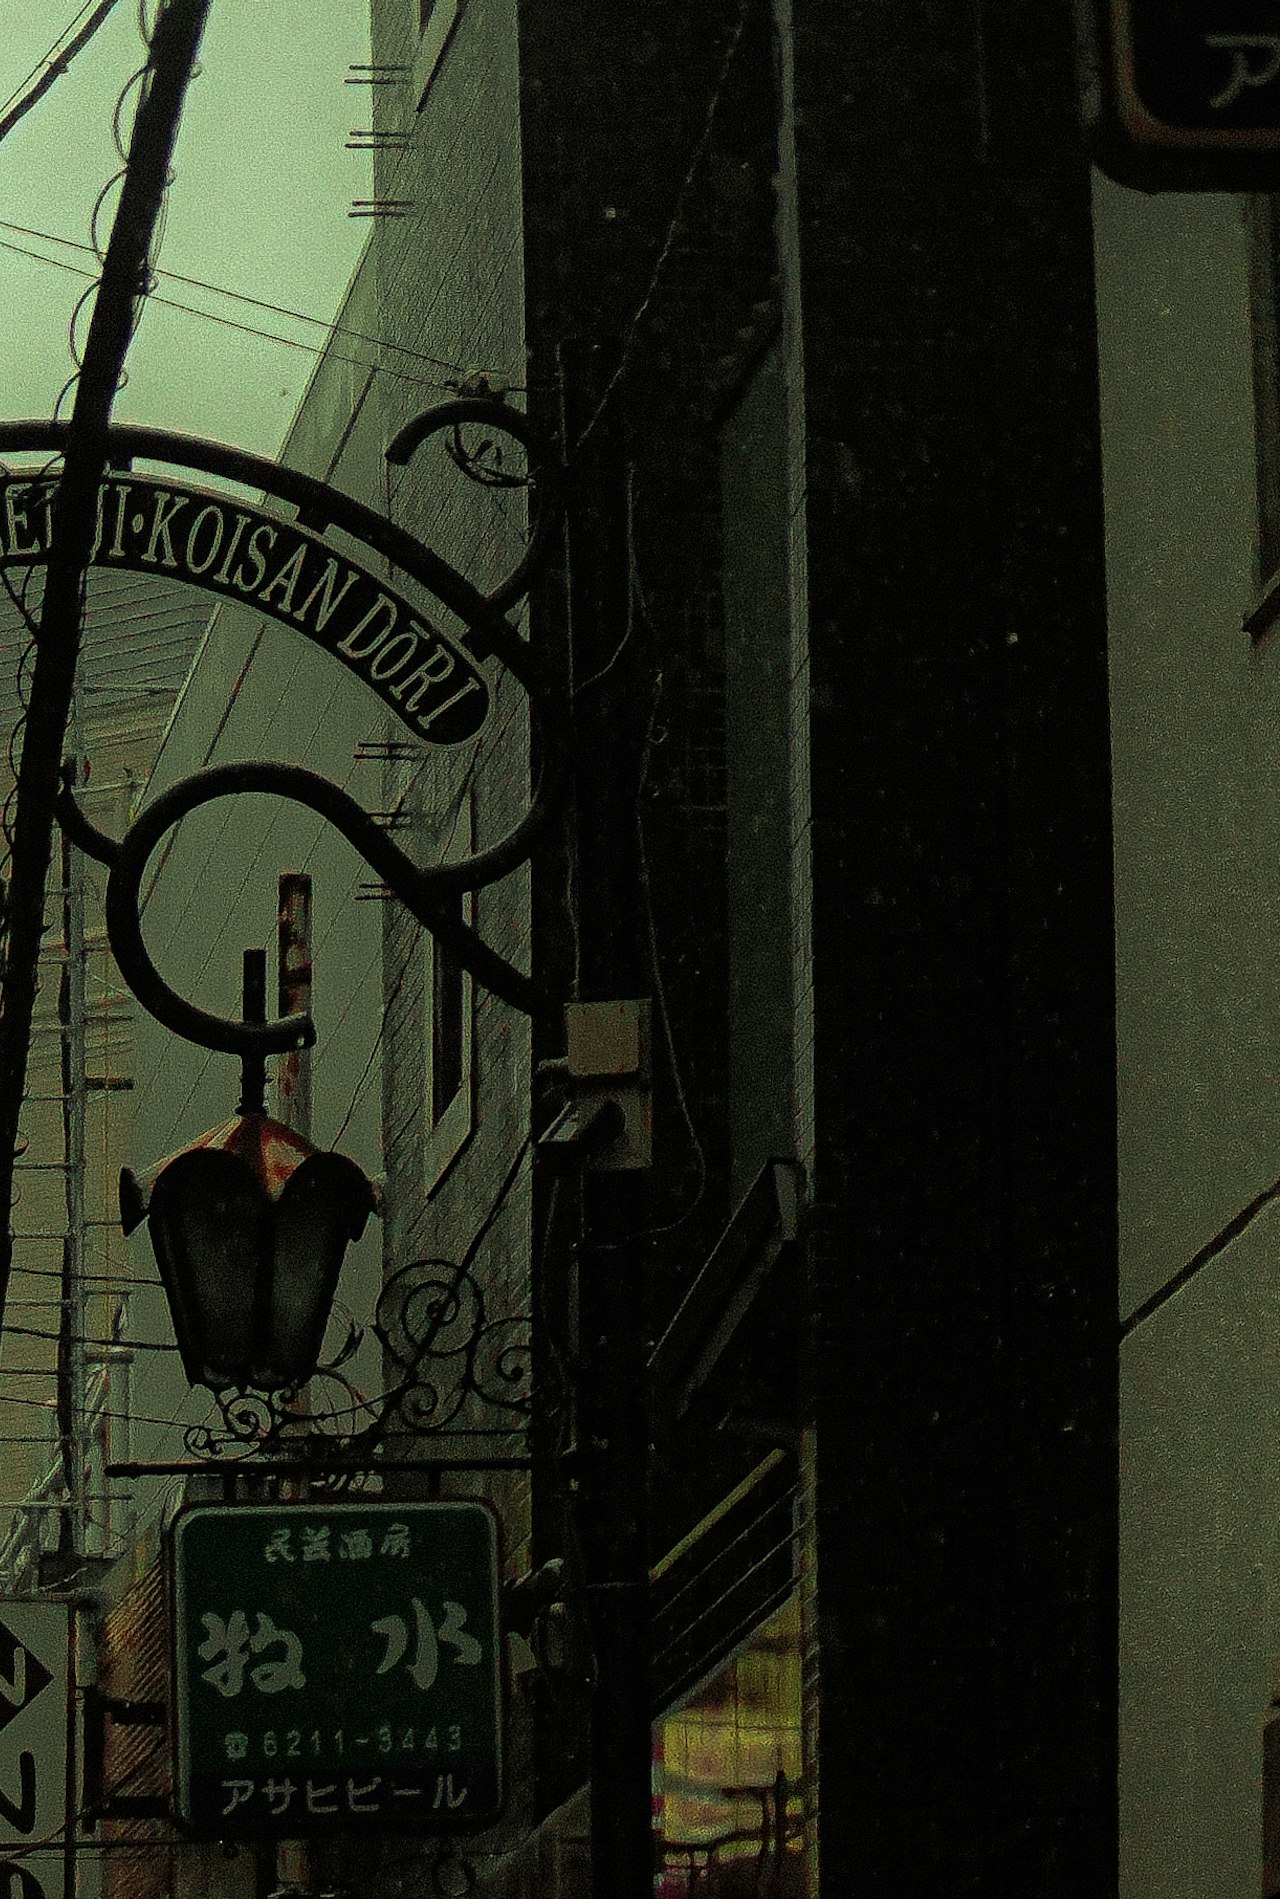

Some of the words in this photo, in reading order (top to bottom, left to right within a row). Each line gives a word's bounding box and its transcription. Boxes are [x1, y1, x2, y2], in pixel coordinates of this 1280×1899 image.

[220, 1772, 469, 1816] アサヒビール
